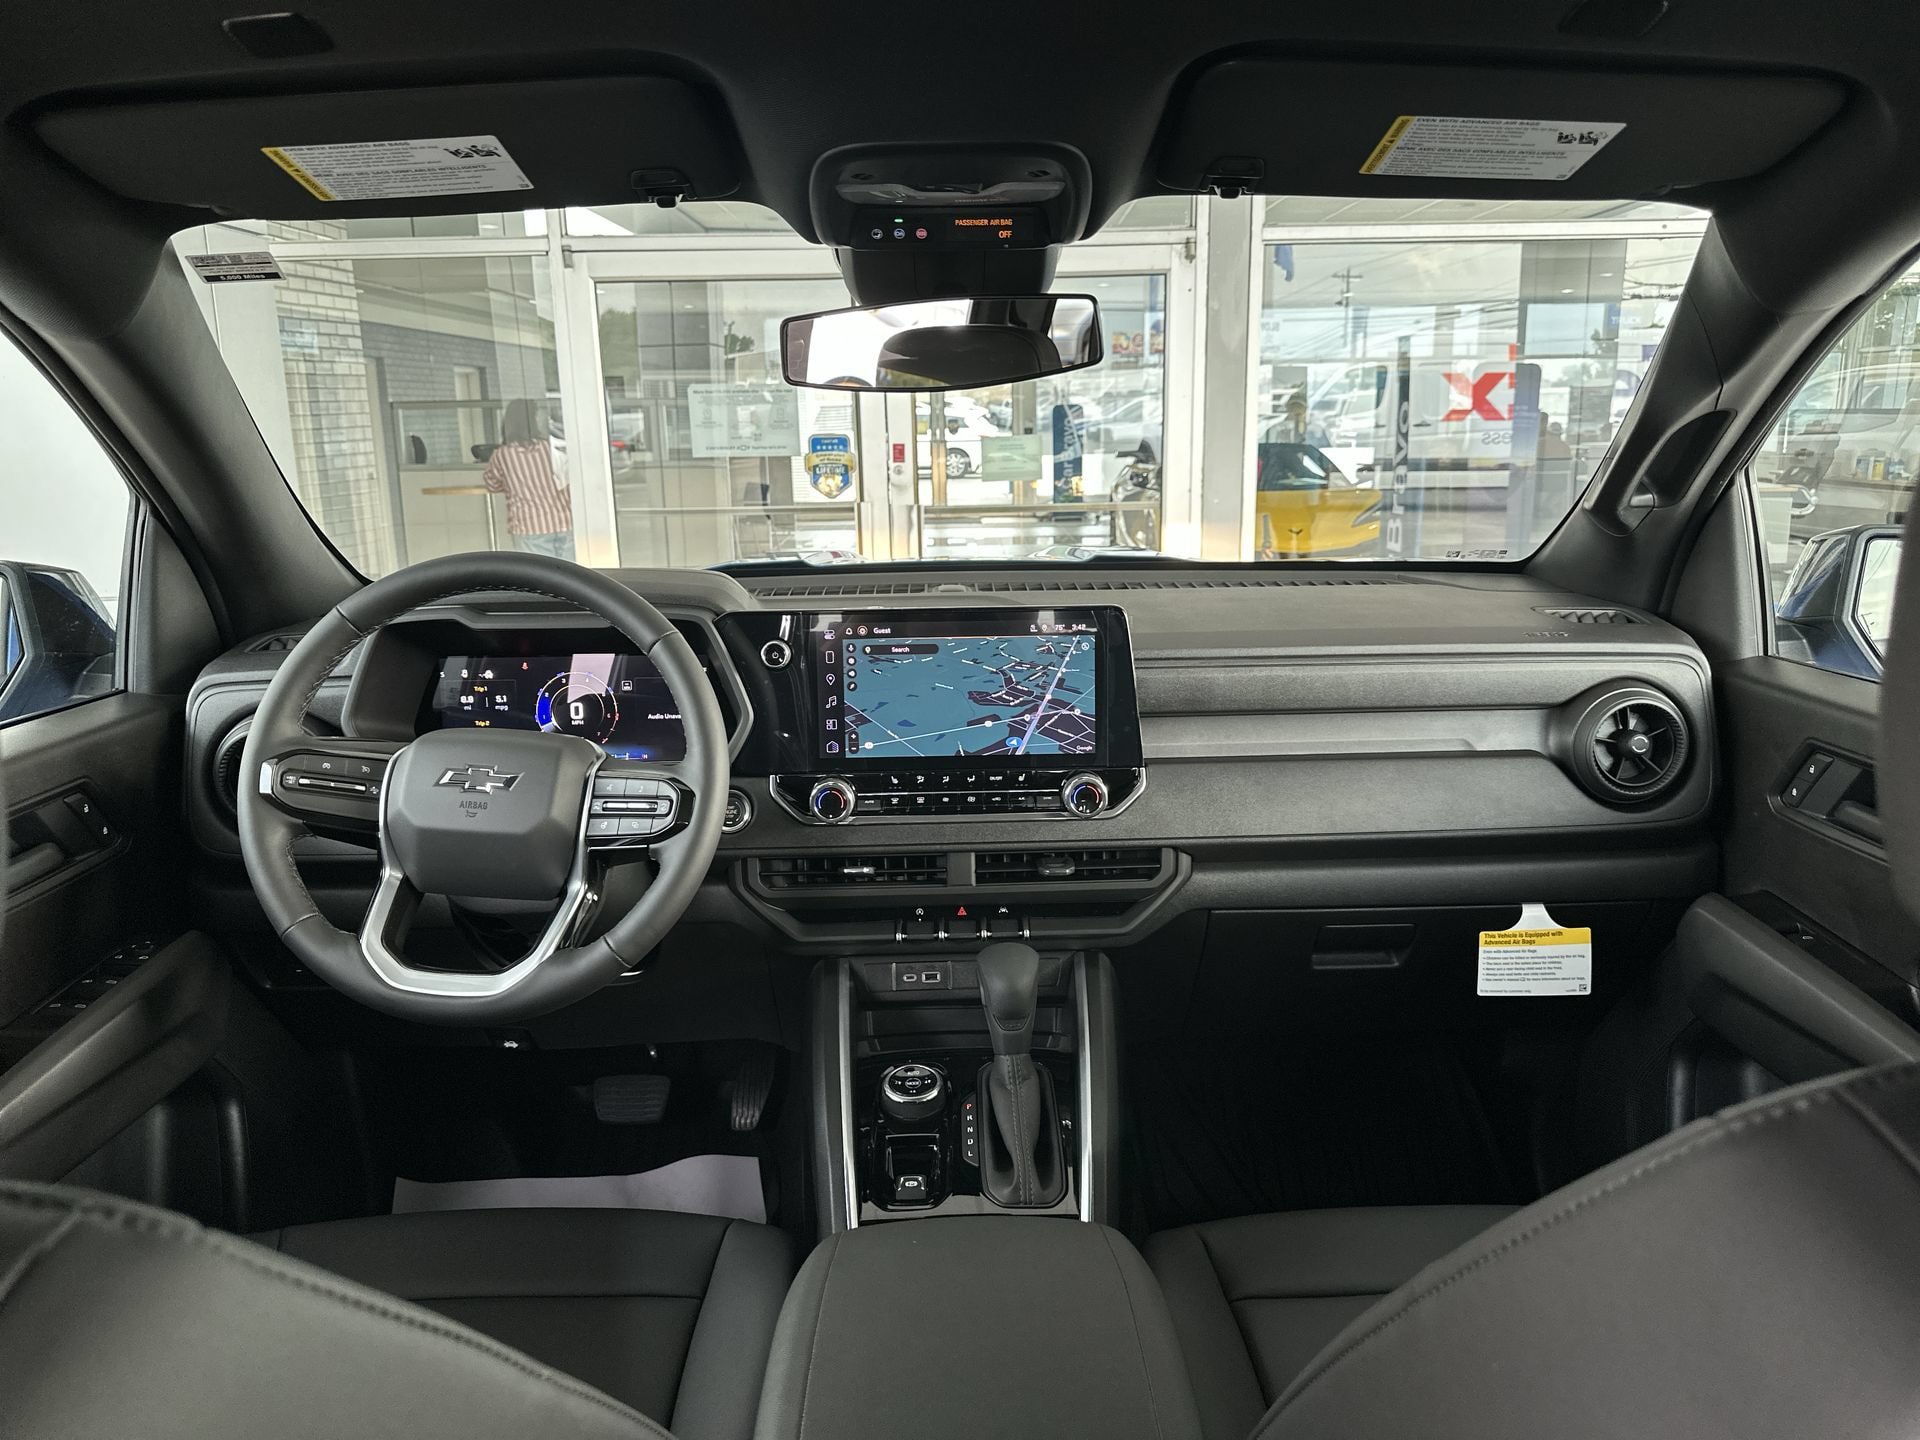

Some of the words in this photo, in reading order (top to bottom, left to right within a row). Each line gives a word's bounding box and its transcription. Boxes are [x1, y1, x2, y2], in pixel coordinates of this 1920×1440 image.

[999, 231, 1013, 239] OFF
[873, 627, 892, 635] Guest
[495, 694, 507, 703] 5.1
[569, 702, 584, 720] 0
[648, 713, 664, 721] Audio
[458, 801, 488, 810] AIRBAG
[1525, 931, 1550, 940] Equipped
